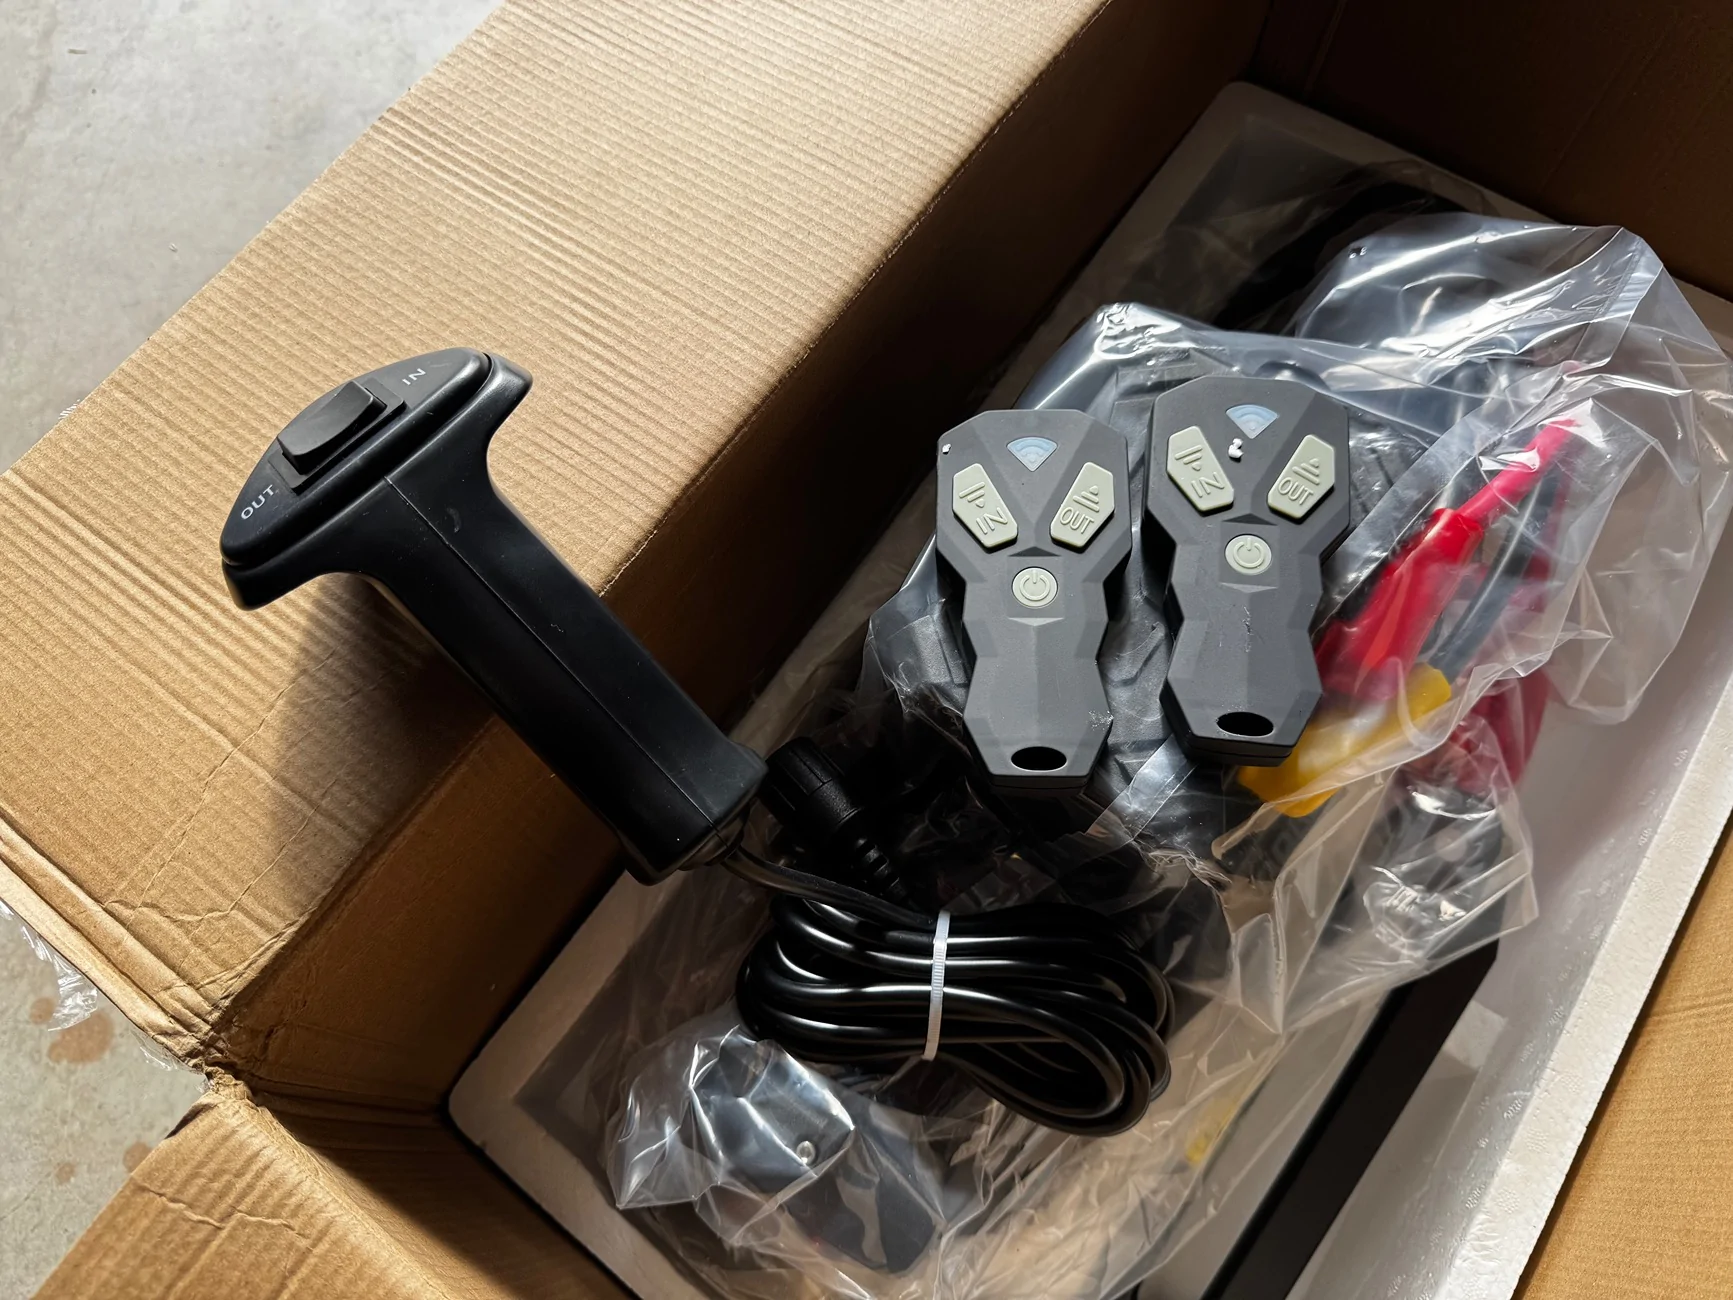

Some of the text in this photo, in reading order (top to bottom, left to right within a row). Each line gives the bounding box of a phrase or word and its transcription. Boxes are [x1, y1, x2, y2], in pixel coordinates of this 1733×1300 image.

[402, 368, 426, 386] IN
[1191, 471, 1226, 498] IN
[1278, 477, 1314, 506] OUT
[240, 484, 274, 520] OUT
[975, 507, 1009, 535] IN
[1060, 507, 1095, 535] OUT
